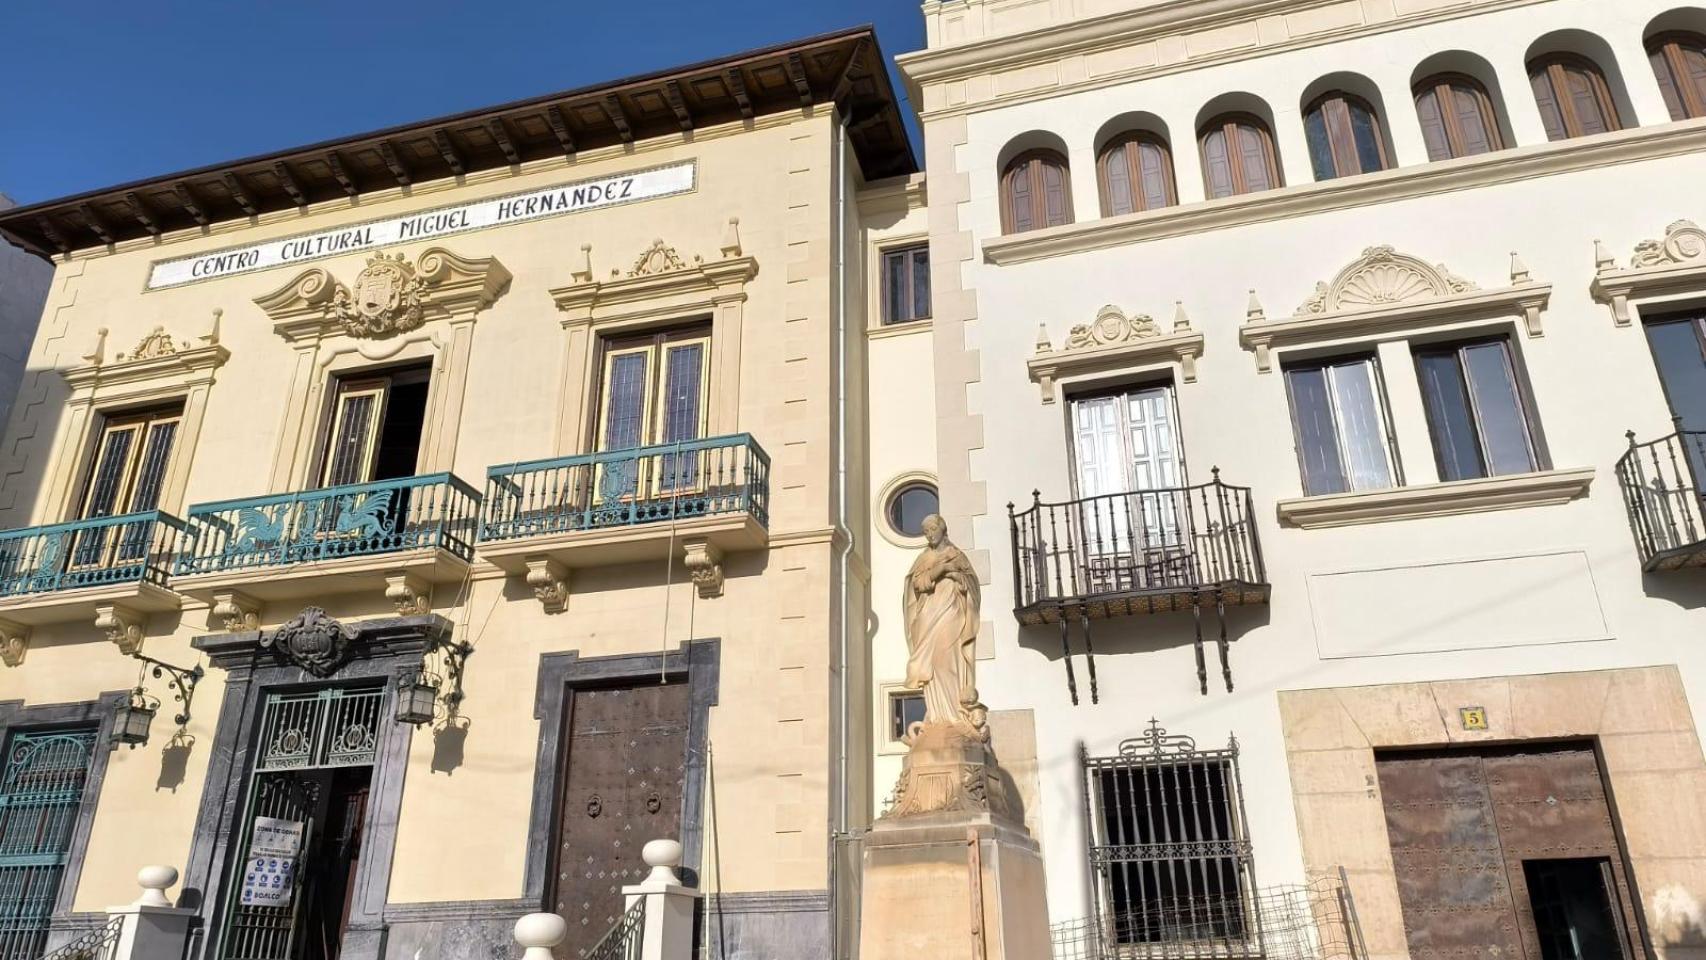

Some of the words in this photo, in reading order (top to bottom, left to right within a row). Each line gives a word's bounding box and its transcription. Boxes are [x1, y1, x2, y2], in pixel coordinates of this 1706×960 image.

[192, 249, 259, 277] CENTRO
[281, 227, 374, 260] CULTURAL
[400, 209, 470, 239] MIGUEL
[497, 179, 634, 220] HERNANDEZ
[1469, 712, 1479, 724] 5
